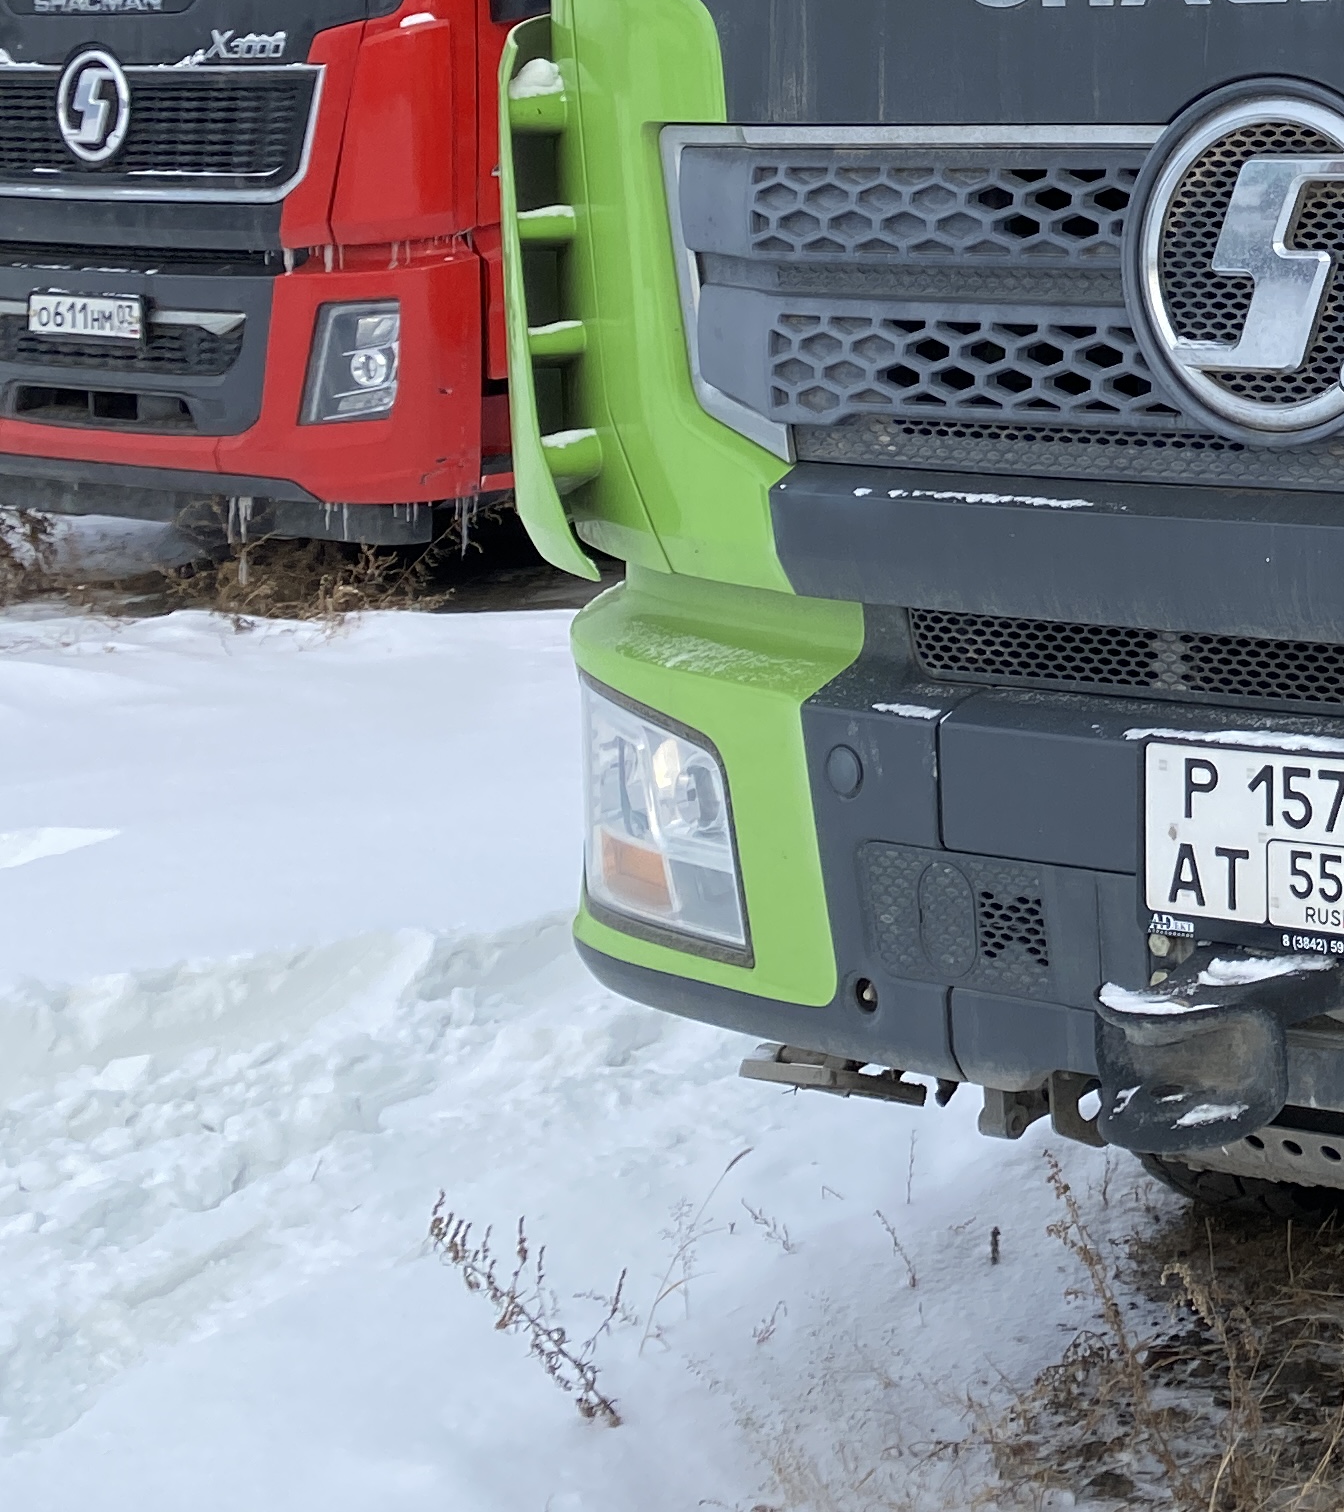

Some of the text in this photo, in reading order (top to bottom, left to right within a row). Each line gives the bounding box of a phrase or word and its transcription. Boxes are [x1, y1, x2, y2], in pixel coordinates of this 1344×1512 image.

[204, 29, 287, 59] X3000
[1305, 906, 1341, 927] RUS
[1281, 934, 1290, 947] 8
[1292, 935, 1327, 954] (3842)
